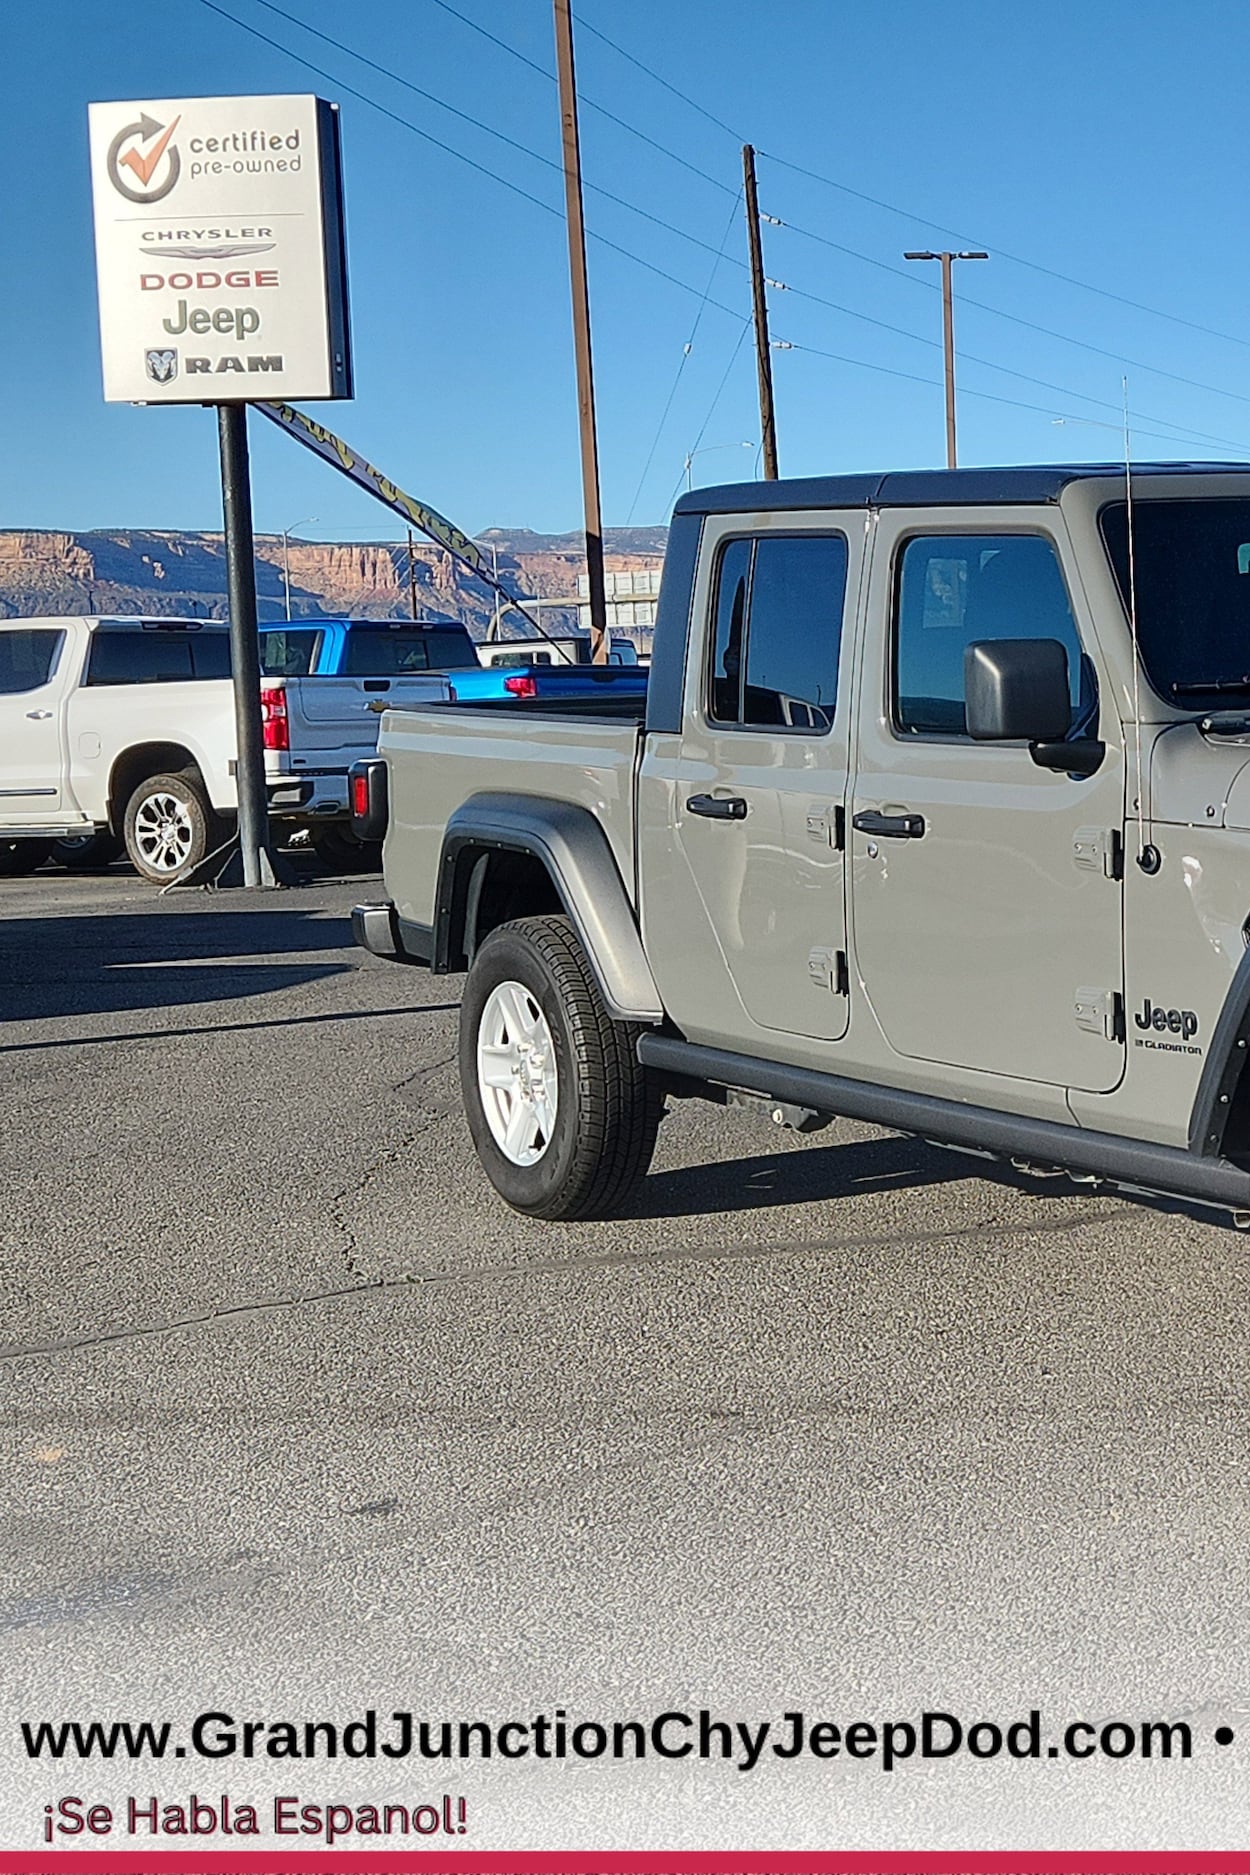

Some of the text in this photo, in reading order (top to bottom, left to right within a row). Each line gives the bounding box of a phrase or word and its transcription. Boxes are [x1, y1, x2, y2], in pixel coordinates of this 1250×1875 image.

[190, 129, 301, 154] certified
[190, 154, 302, 180] pre-owned
[141, 227, 273, 242] CHRYSLER
[140, 269, 280, 292] DODGE
[162, 299, 261, 341] Jeep
[185, 354, 284, 374] RAM
[1134, 998, 1198, 1041] Jeep
[1144, 1040, 1203, 1056] GLADIATOR
